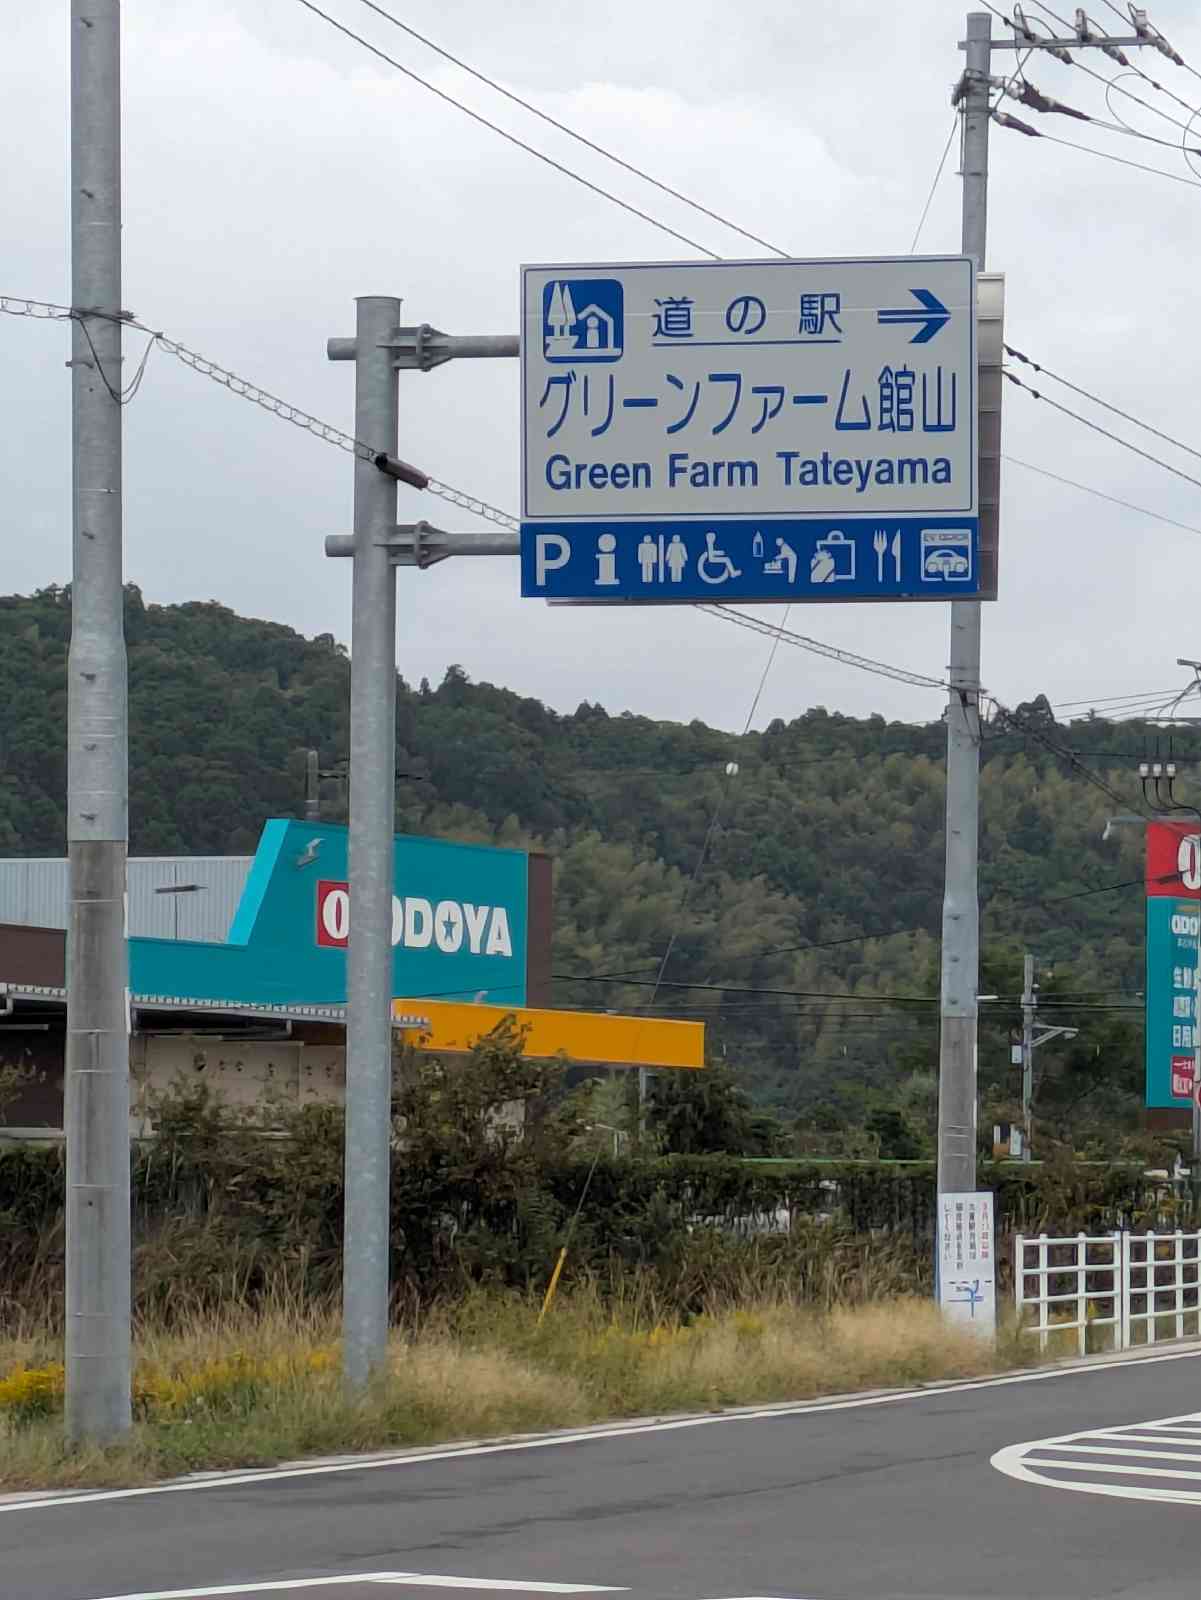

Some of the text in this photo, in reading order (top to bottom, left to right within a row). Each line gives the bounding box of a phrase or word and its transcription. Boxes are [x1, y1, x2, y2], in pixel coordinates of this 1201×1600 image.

[652, 293, 842, 337] 道の駅
[539, 363, 956, 438] グリーンファーム館山
[545, 451, 952, 493] Green Farm Tateyama
